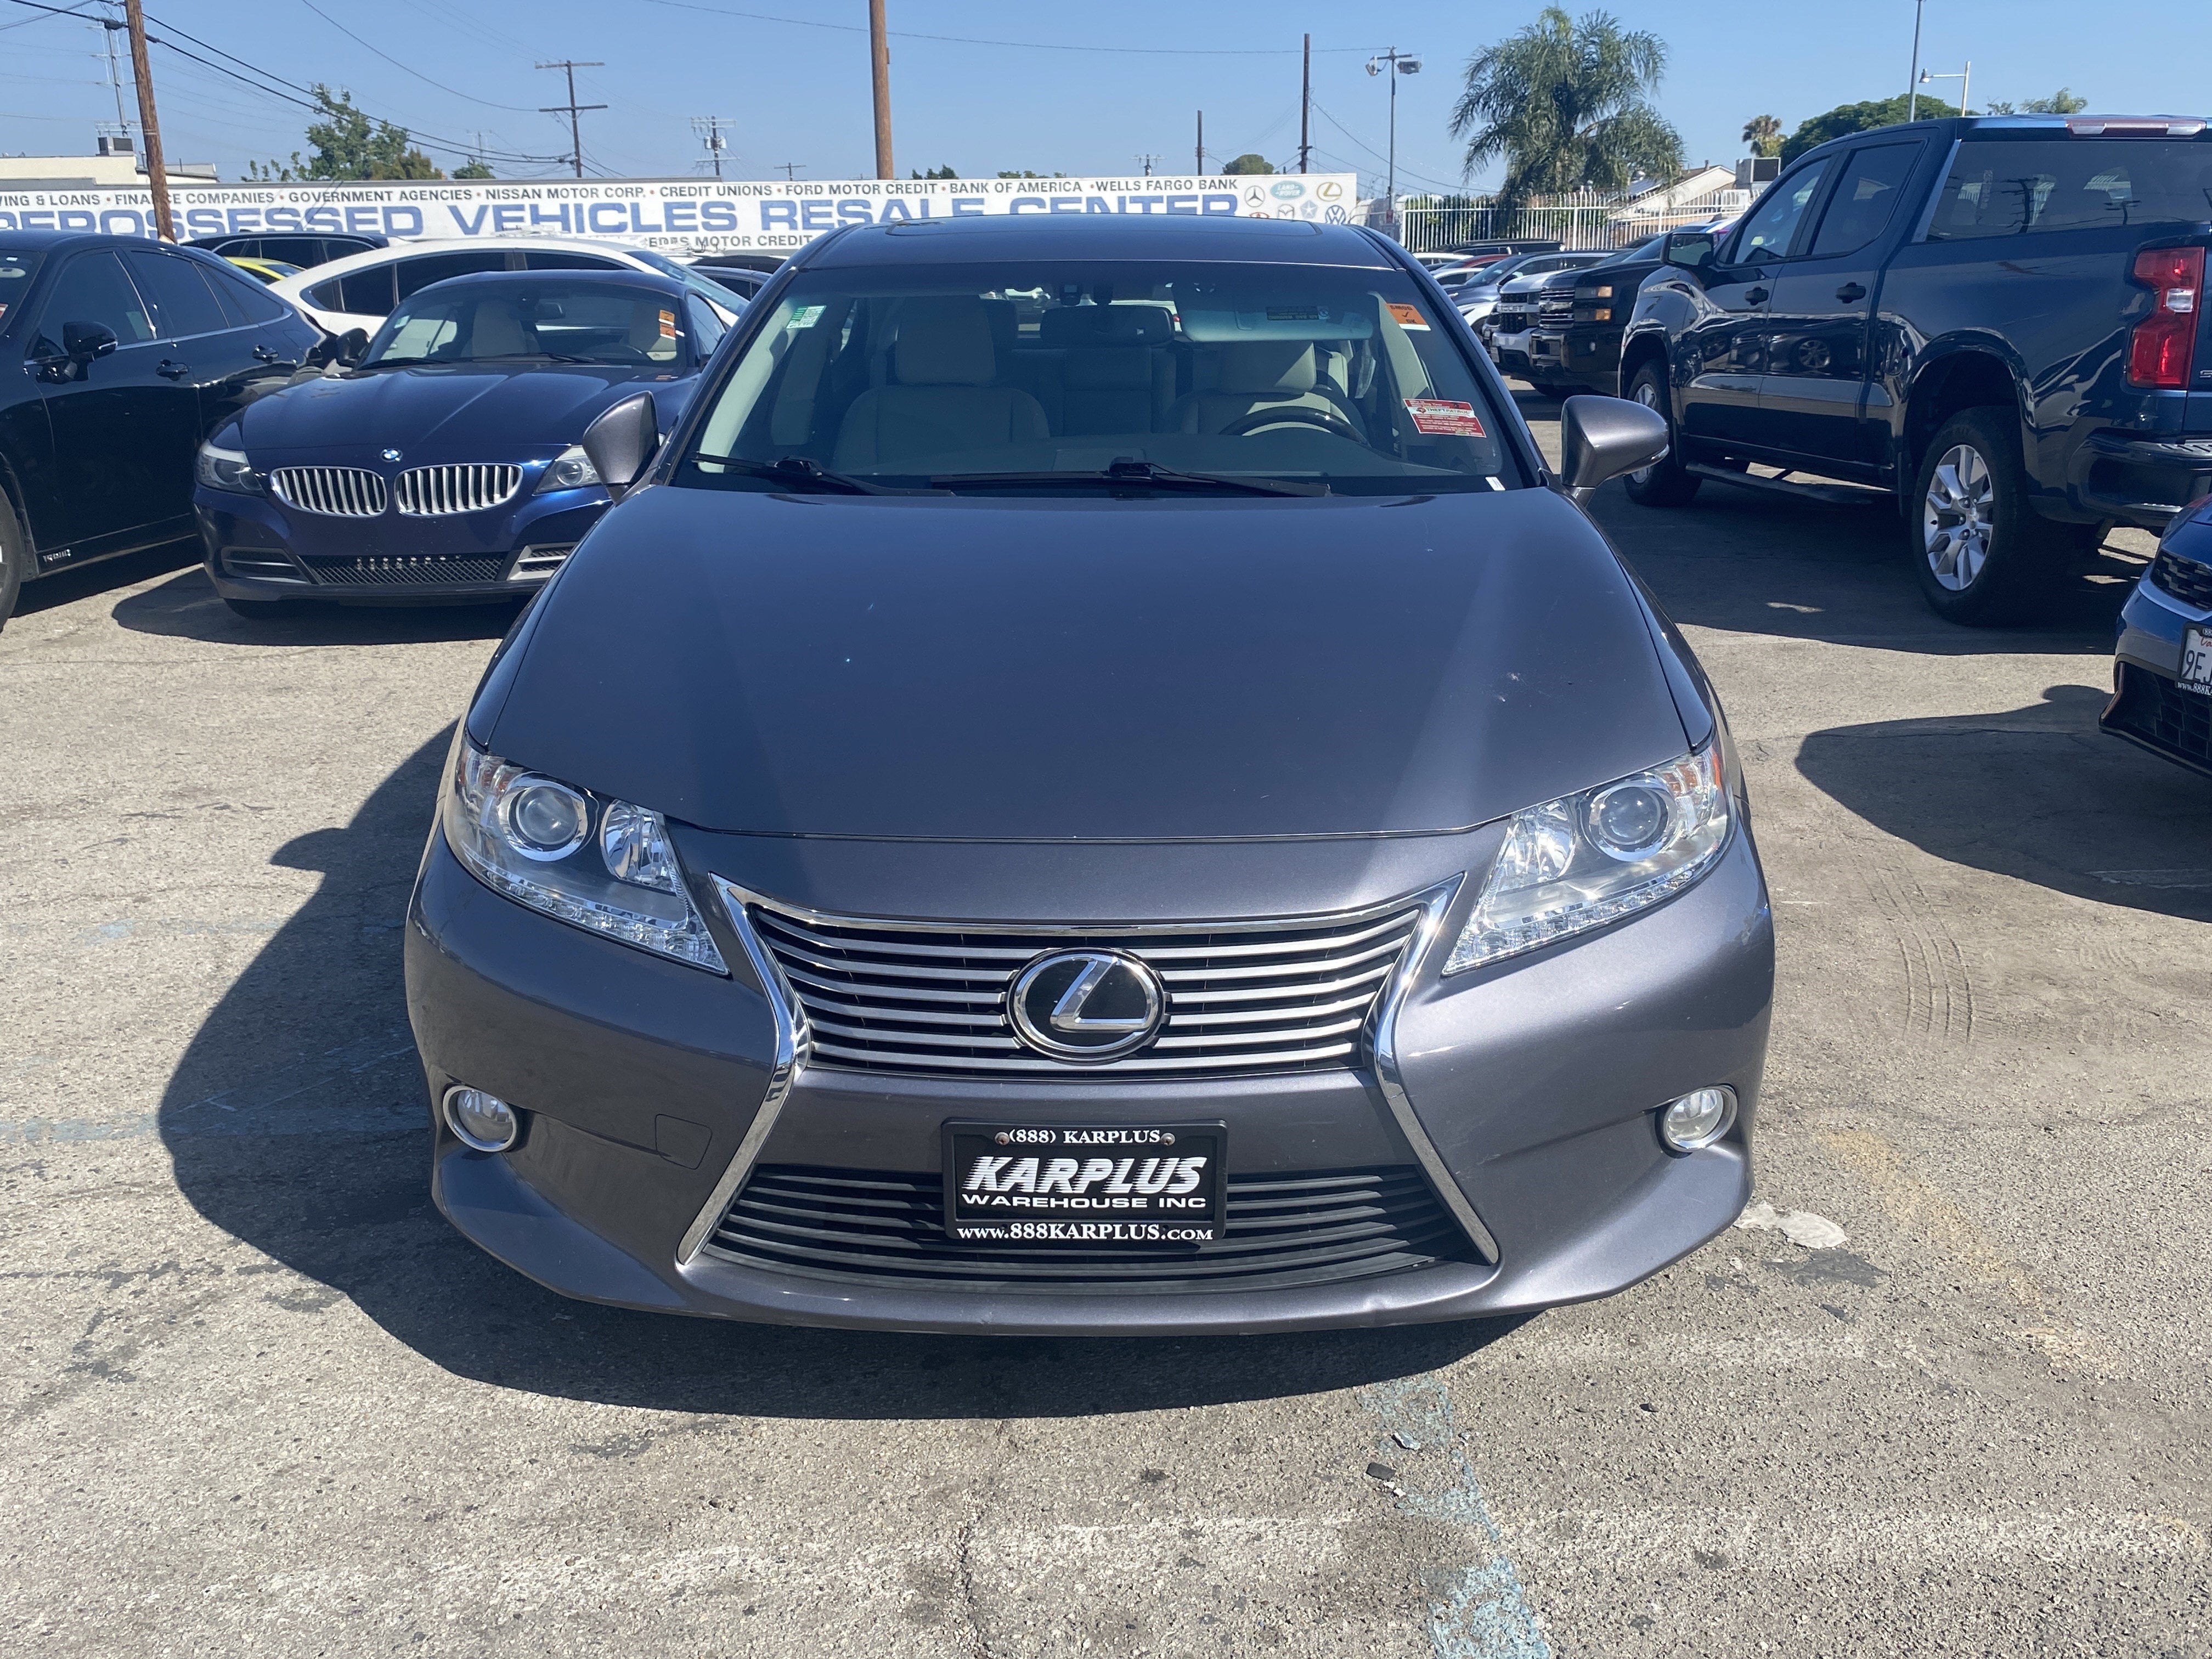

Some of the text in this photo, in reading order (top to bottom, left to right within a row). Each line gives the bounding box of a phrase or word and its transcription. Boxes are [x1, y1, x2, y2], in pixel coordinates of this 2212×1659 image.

[36, 194, 45, 206] &
[50, 194, 100, 206] LOANS
[115, 193, 181, 205] FINAE
[186, 192, 274, 204] COMPANIES
[289, 190, 392, 202] GOVERNMENT
[399, 189, 472, 201] AGENCIES
[486, 188, 542, 200] NISSAN
[548, 187, 599, 199] MOTOR
[605, 187, 646, 198] CORP.
[660, 185, 712, 197] CREDIT
[716, 185, 772, 196] UNIONS
[786, 184, 822, 195] FORD
[829, 184, 881, 195] MOTOR
[886, 183, 938, 194] CREDIT
[950, 182, 989, 193] BANK
[994, 182, 1012, 193] OF
[1017, 181, 1083, 192] AMERICA
[1096, 180, 1141, 191] WELLS
[1147, 179, 1193, 191] FARGO
[1199, 179, 1238, 190] BANK
[447, 200, 737, 235] VEHICLES
[696, 235, 751, 247] MOTOR
[758, 235, 813, 246] CREDIT
[1008, 1128, 1160, 1144] (888) KARPLUS
[961, 1155, 1207, 1194] KARPLUS
[962, 1194, 1206, 1208] WAREHOUSE INC
